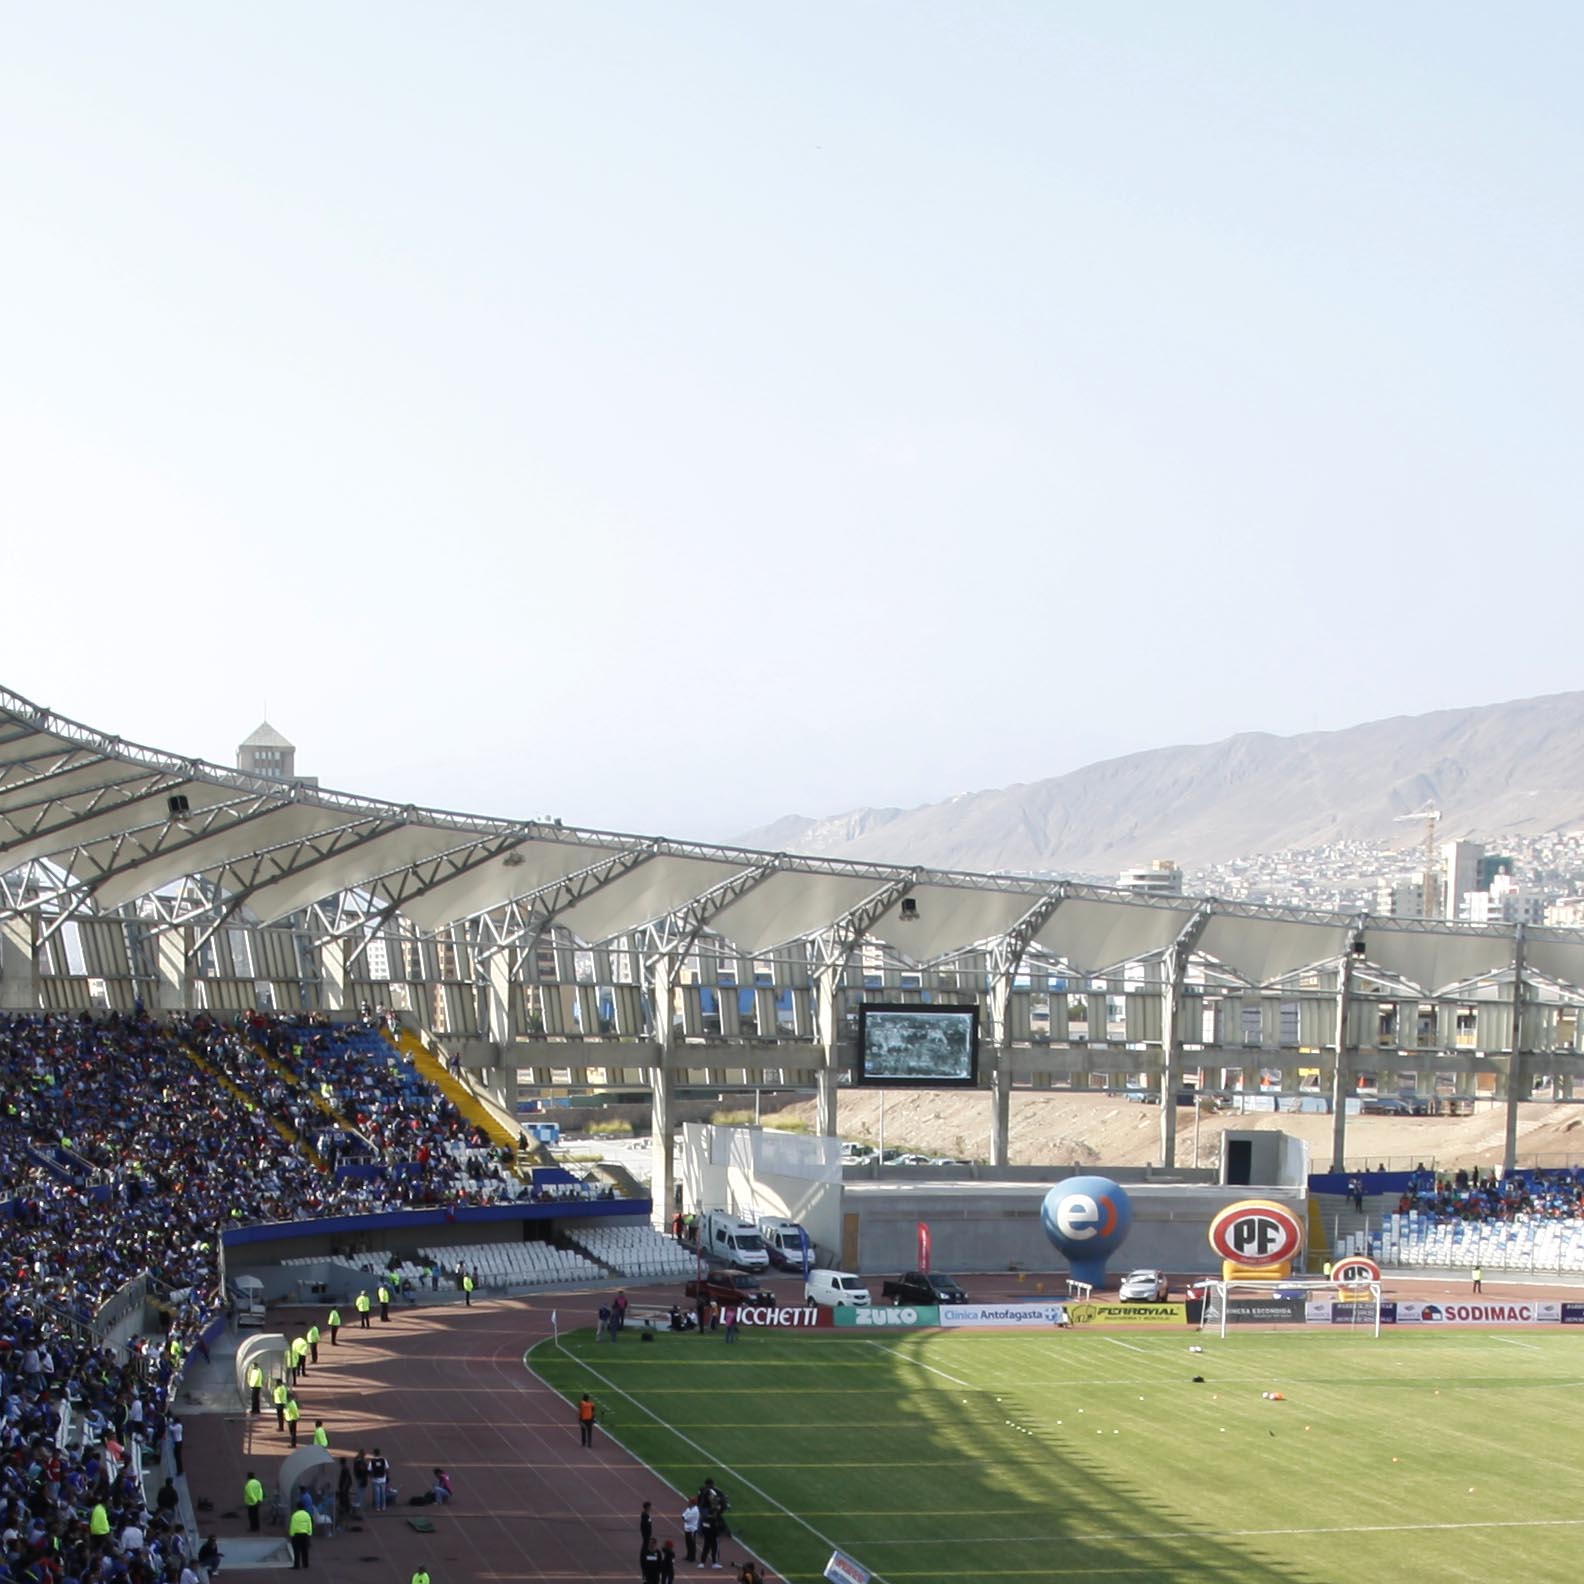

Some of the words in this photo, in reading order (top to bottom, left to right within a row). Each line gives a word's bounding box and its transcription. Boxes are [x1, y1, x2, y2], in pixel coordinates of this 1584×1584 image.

[1233, 1217, 1280, 1255] PF
[855, 1307, 918, 1325] ZUKO
[980, 1309, 1043, 1323] Antofagasta
[1097, 1307, 1179, 1316] FERROVIAL
[1444, 1305, 1533, 1321] SODIMAC
